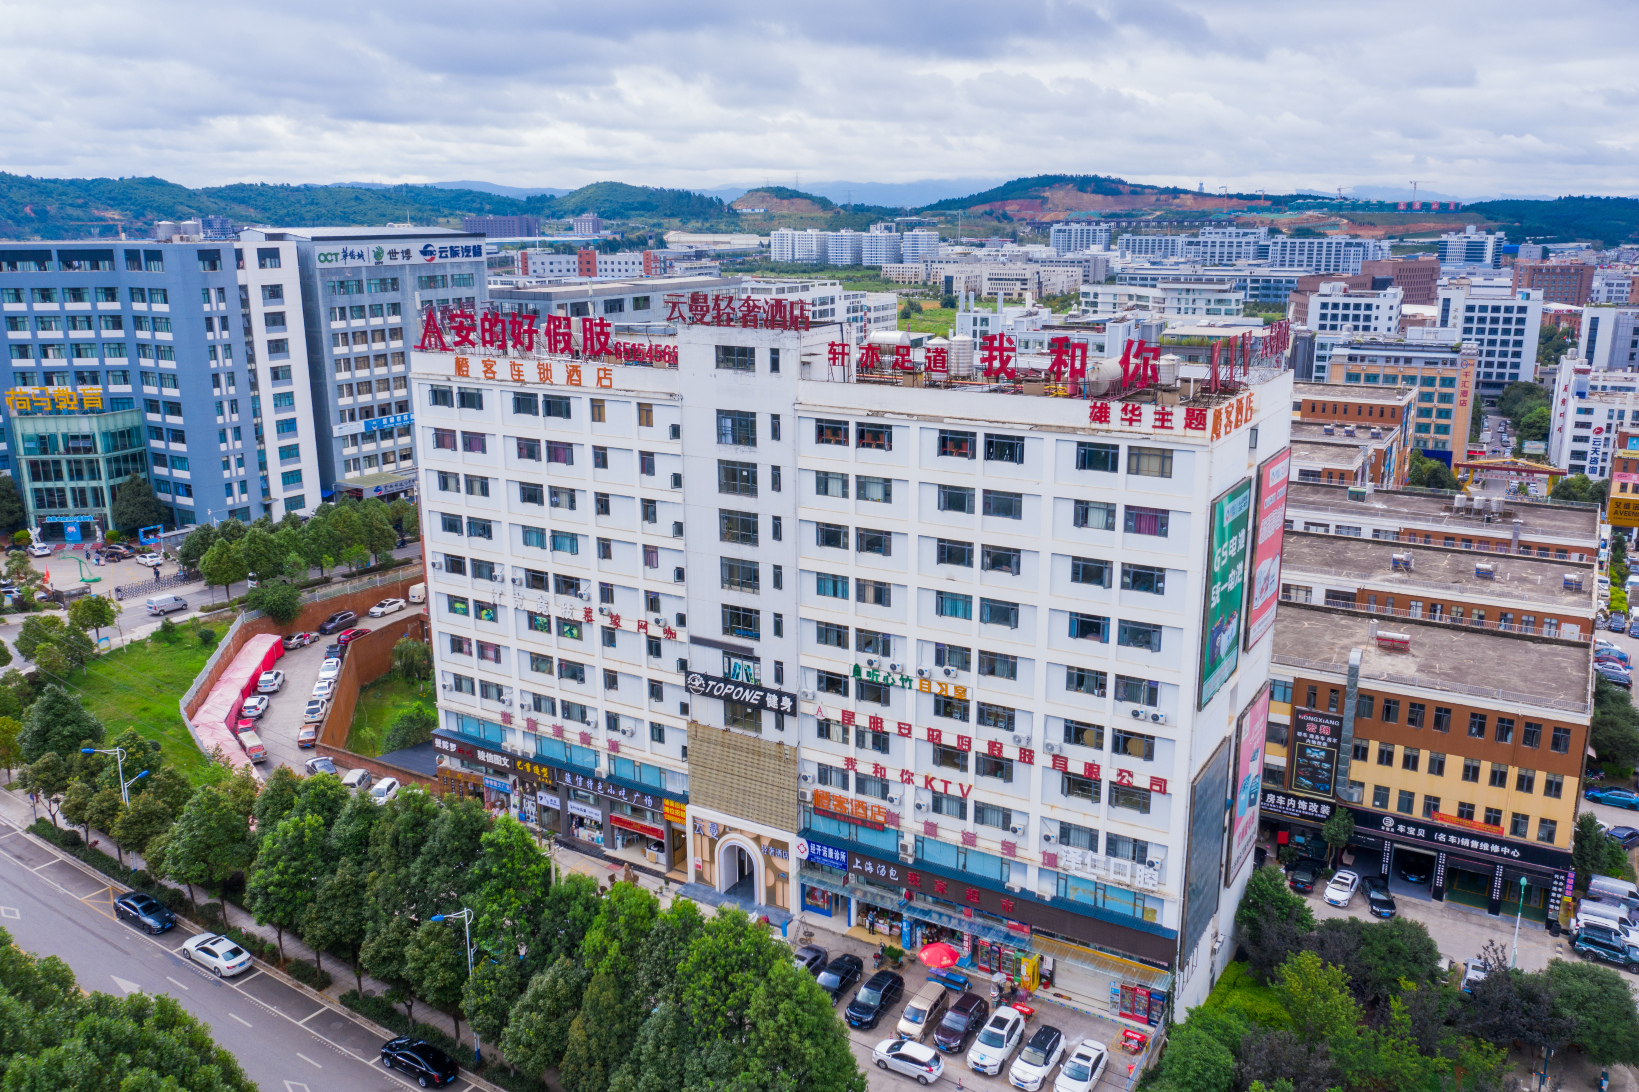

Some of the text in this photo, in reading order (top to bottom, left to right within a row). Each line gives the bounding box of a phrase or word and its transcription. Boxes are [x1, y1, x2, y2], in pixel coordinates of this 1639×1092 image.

[387, 248, 413, 261] 世博
[664, 293, 812, 331] 云曼轻奢酒店
[450, 308, 613, 356] 安的好假肢
[455, 356, 613, 388] 橙客连锁酒店
[828, 341, 949, 373] 轩亦足道
[980, 333, 1161, 389] 我和你
[1089, 401, 1208, 431] 雄华主题
[1211, 392, 1255, 442] 橙客酒店
[1588, 437, 1602, 475] 云天咨询
[1214, 527, 1246, 573] GS电池
[705, 680, 793, 713] TOPONE 健身
[1298, 714, 1340, 726] HONGXIANG
[1306, 723, 1331, 736] 宏翔
[841, 709, 1168, 795] 昆明安的好假肢有限公司
[844, 756, 973, 799] 我和你KTV
[813, 788, 887, 825] 橙客酒店
[1266, 793, 1331, 816] 房车内饰改装
[693, 818, 719, 840] 云曼
[760, 844, 789, 860] 轻奢酒店
[852, 857, 899, 881] 上海汤包
[907, 871, 1015, 914] 我家超市
